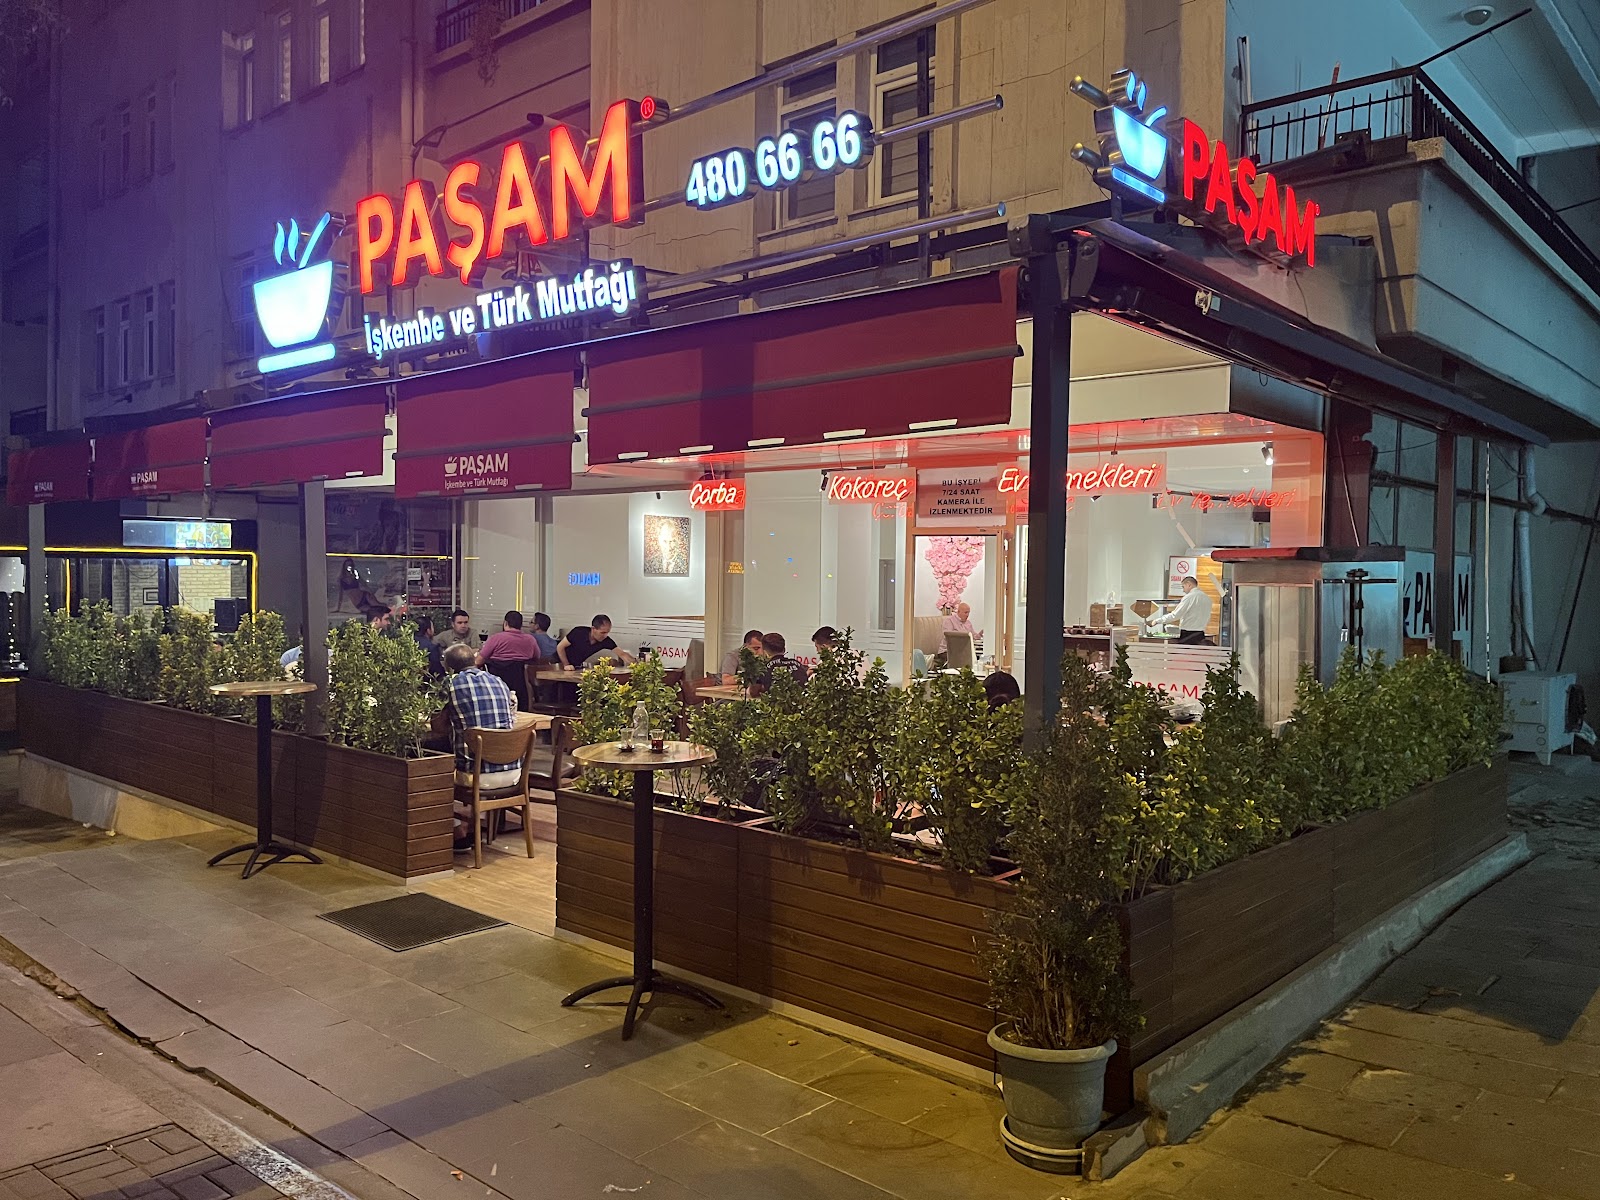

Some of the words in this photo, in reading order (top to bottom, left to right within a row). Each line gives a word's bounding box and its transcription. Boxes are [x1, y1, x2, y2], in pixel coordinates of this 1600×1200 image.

[686, 151, 747, 206] 480
[755, 132, 801, 187] 66
[812, 113, 862, 170] 66
[357, 100, 630, 294] PAŞAM
[1183, 118, 1316, 269] PAŞAM
[363, 314, 445, 360] İşkembe
[448, 306, 476, 336] ve
[476, 284, 533, 330] Türk
[536, 261, 637, 320] Mutfağı
[459, 452, 509, 476] PAŞAM
[474, 478, 486, 487] Türk
[828, 475, 908, 501] Kokoreç
[942, 479, 953, 487] BU
[998, 468, 1029, 492] Ev
[1066, 463, 1157, 490] mekleri
[690, 482, 737, 509] Çorba
[937, 498, 971, 506] KAMERA
[972, 497, 985, 505] İLE
[960, 488, 980, 496] SAAT
[929, 507, 993, 515] İZLENMEKTEDİR
[1413, 572, 1469, 635] PAM
